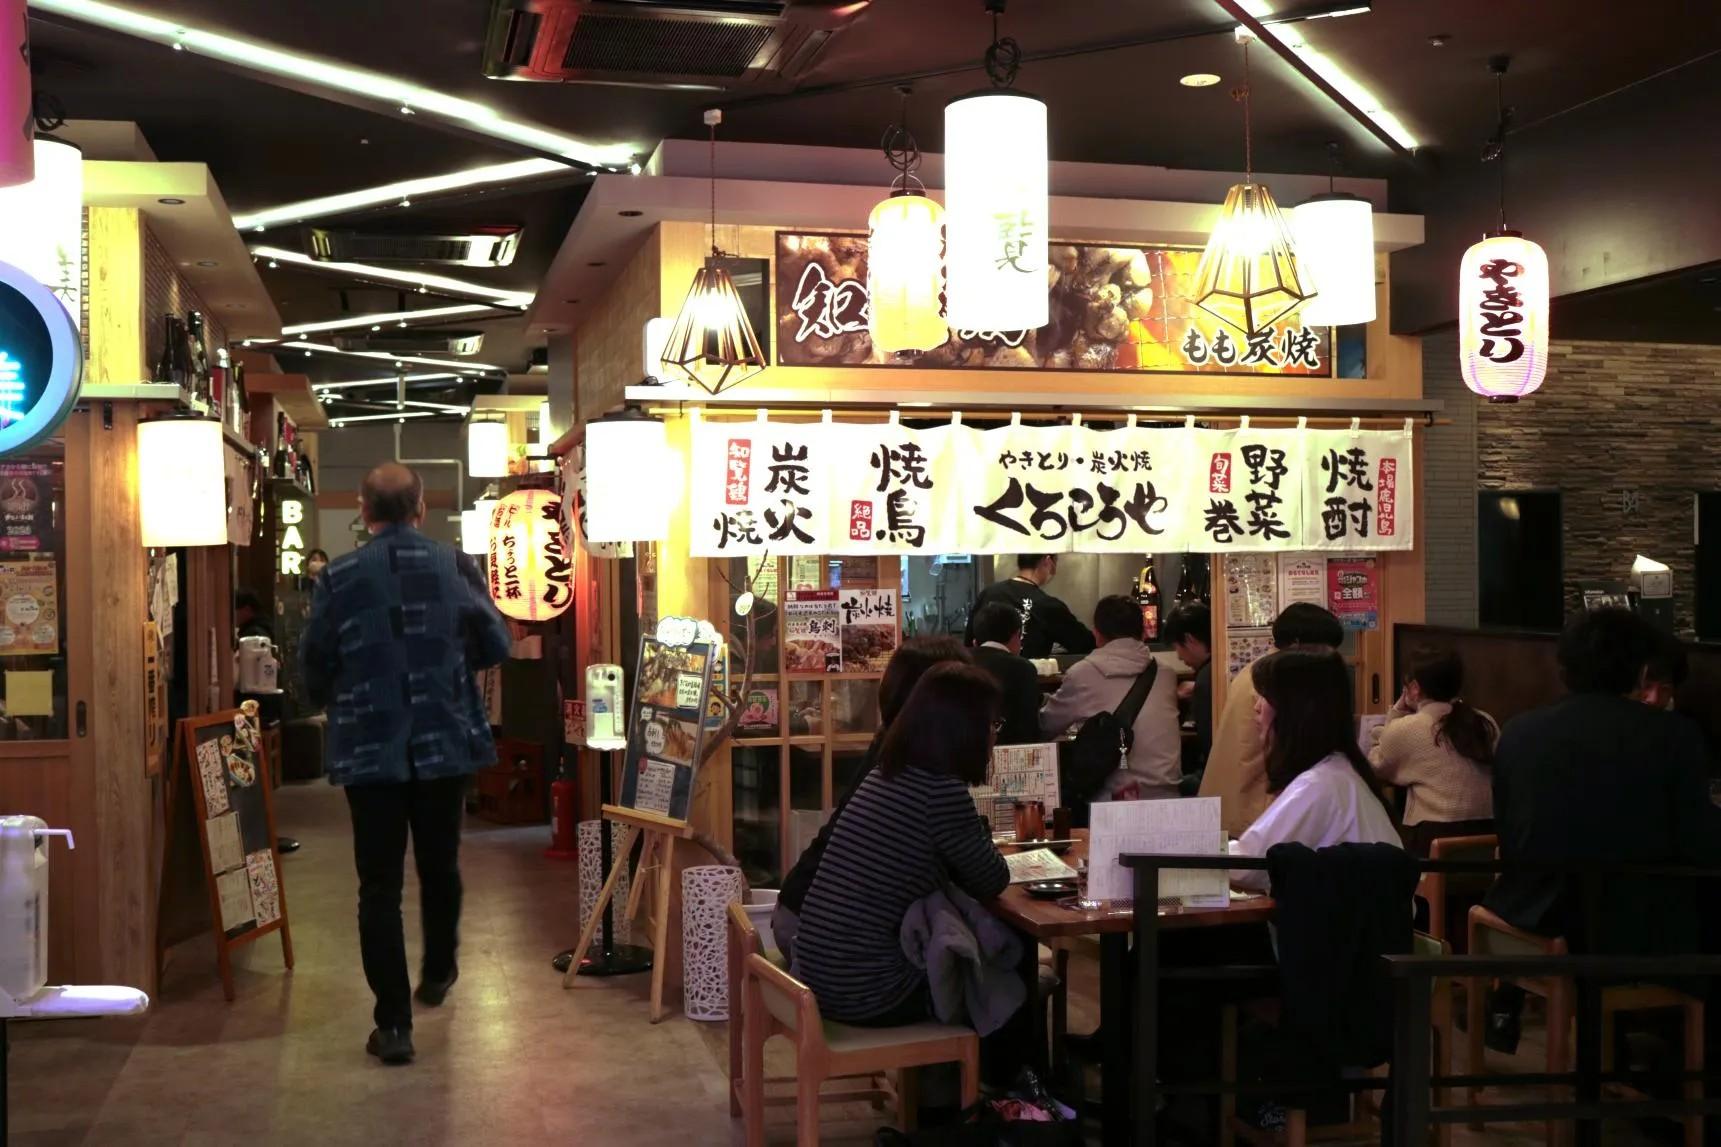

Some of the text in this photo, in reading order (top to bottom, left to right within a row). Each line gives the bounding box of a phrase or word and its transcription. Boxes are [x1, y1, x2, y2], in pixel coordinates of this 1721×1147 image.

[1479, 258, 1525, 364] やきとり
[1183, 327, 1320, 368] もも炭焼
[727, 440, 750, 503] 知覧鶏
[870, 441, 934, 548] 焼鳥
[1211, 453, 1231, 493] 旬菜
[1321, 447, 1374, 541] 焼酎
[1378, 458, 1396, 536] 本場鹿児島
[281, 500, 303, 575] BAR
[851, 502, 872, 540] 絶品
[503, 535, 523, 600] ちょっと一杯
[841, 594, 895, 624] 炭火焼
